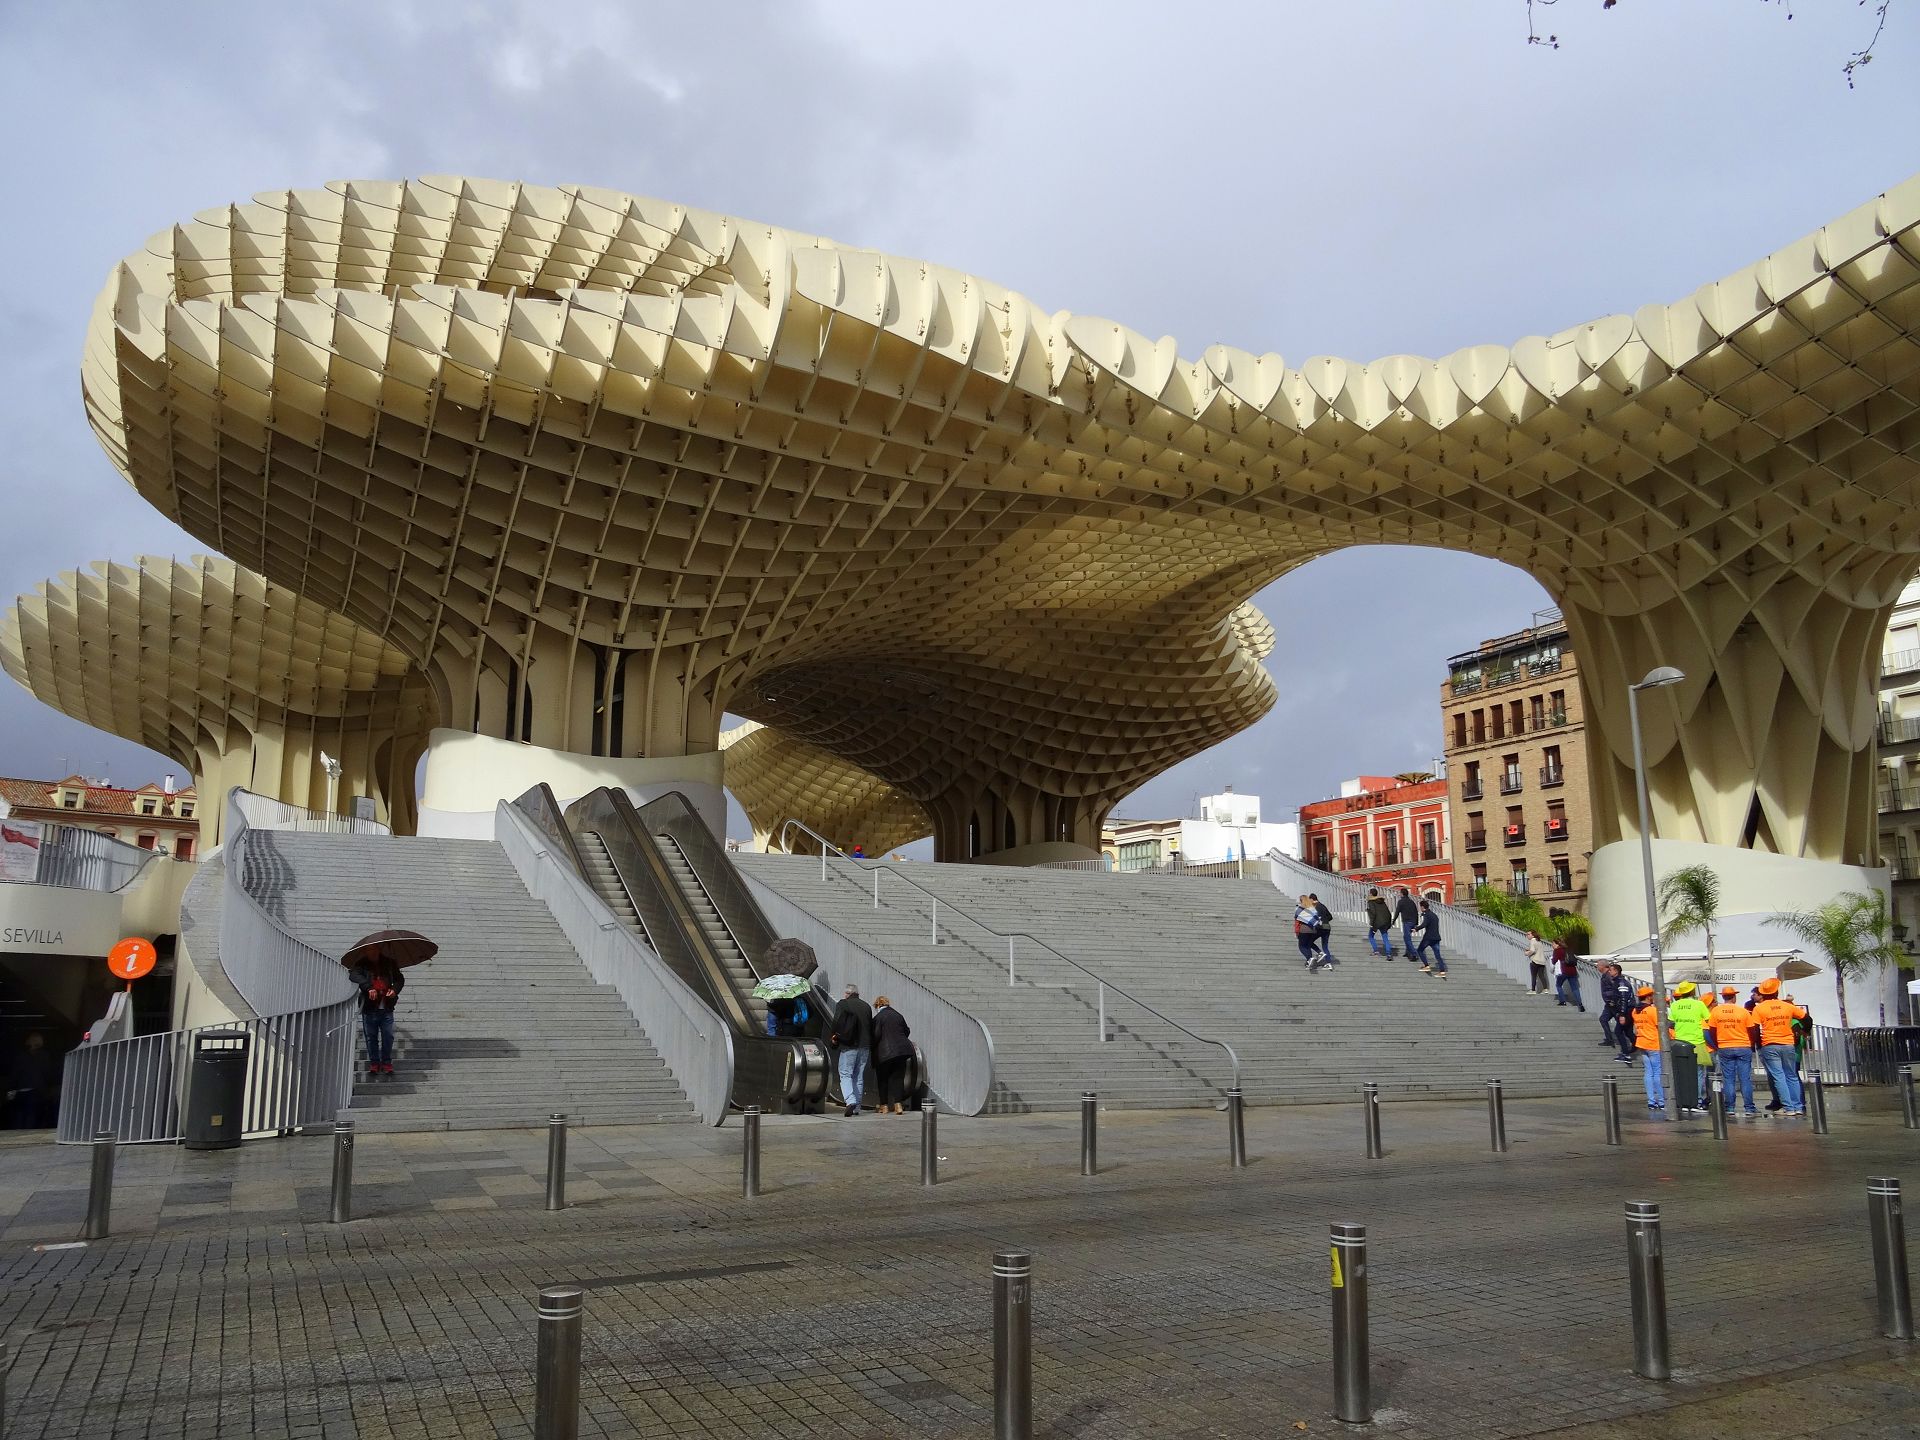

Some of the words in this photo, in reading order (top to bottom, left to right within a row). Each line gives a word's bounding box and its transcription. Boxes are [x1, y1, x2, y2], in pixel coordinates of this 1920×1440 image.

[1345, 791, 1392, 813] HOTEL
[2, 927, 64, 944] SEVILLA
[1739, 973, 1757, 981] TAPAS
